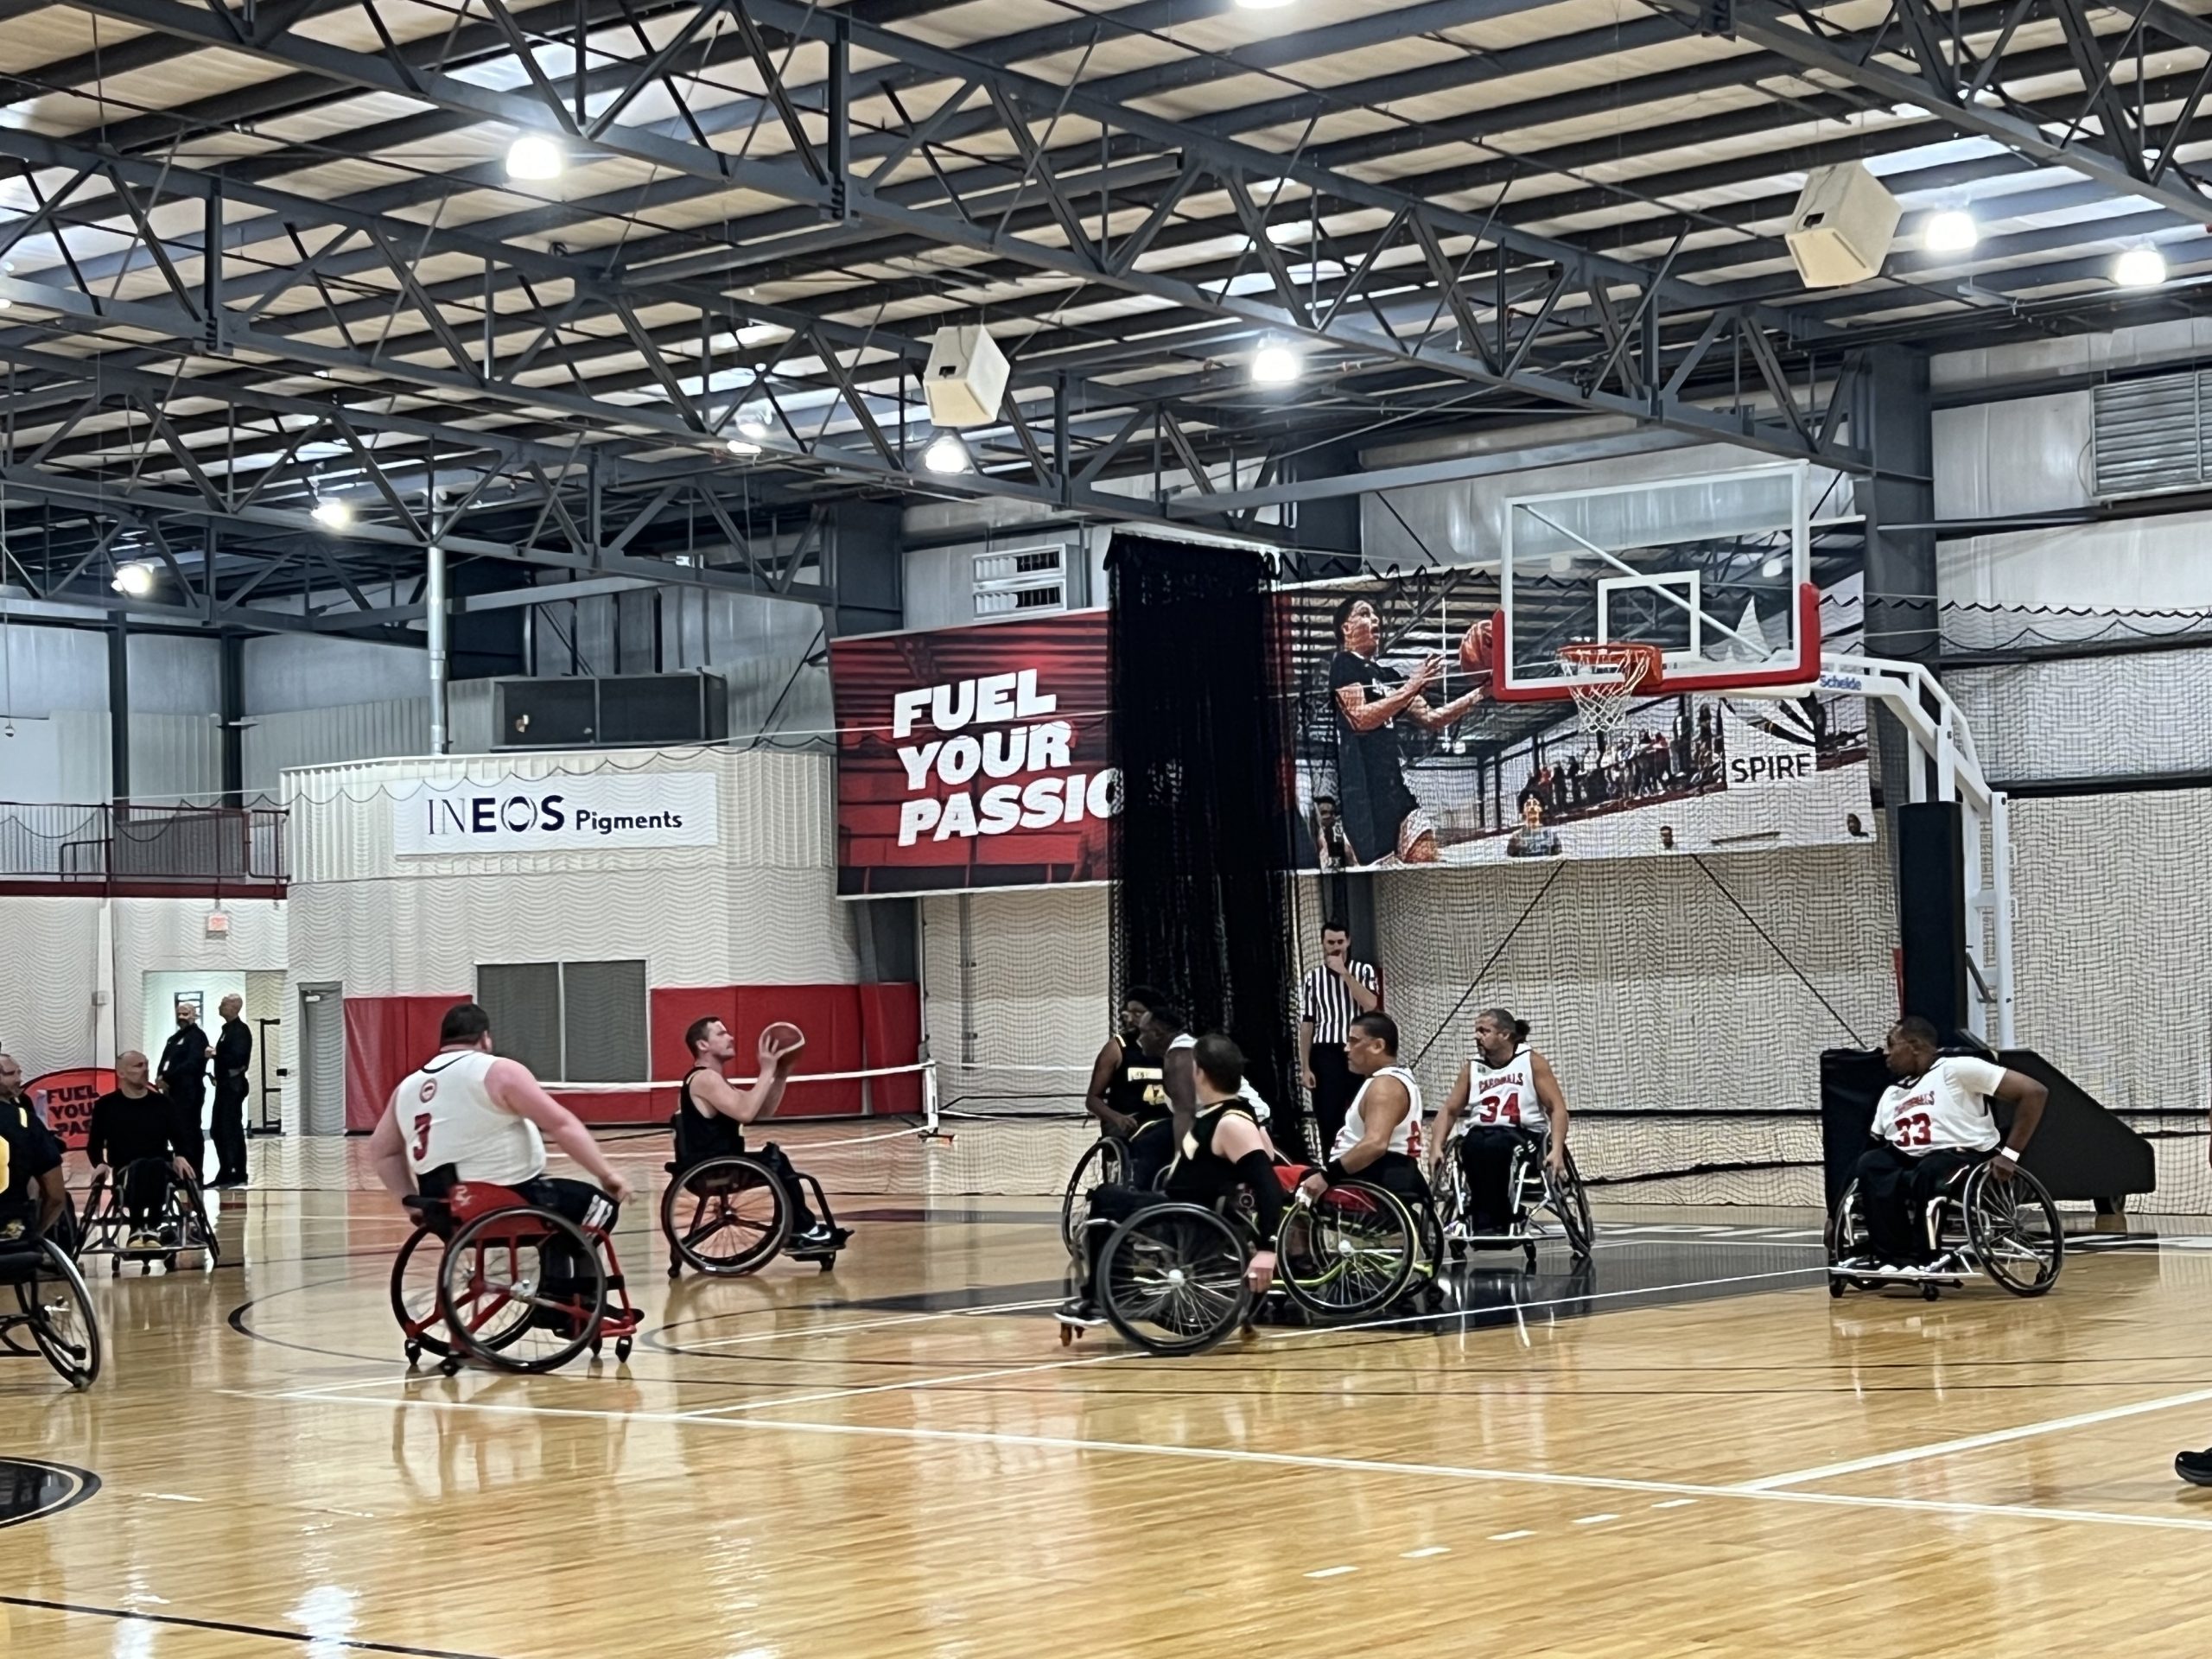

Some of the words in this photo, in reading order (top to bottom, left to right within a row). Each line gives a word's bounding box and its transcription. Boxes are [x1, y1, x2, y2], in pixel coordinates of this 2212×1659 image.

[893, 669, 1057, 739] FUEL
[897, 721, 1071, 790] YOUR
[1731, 753, 1811, 782] SPIRE
[428, 795, 565, 835] INEOS
[575, 810, 683, 835] Pigments
[47, 1084, 99, 1103] FUEL
[1480, 1093, 1521, 1124] 34
[1894, 1113, 1931, 1147] 33
